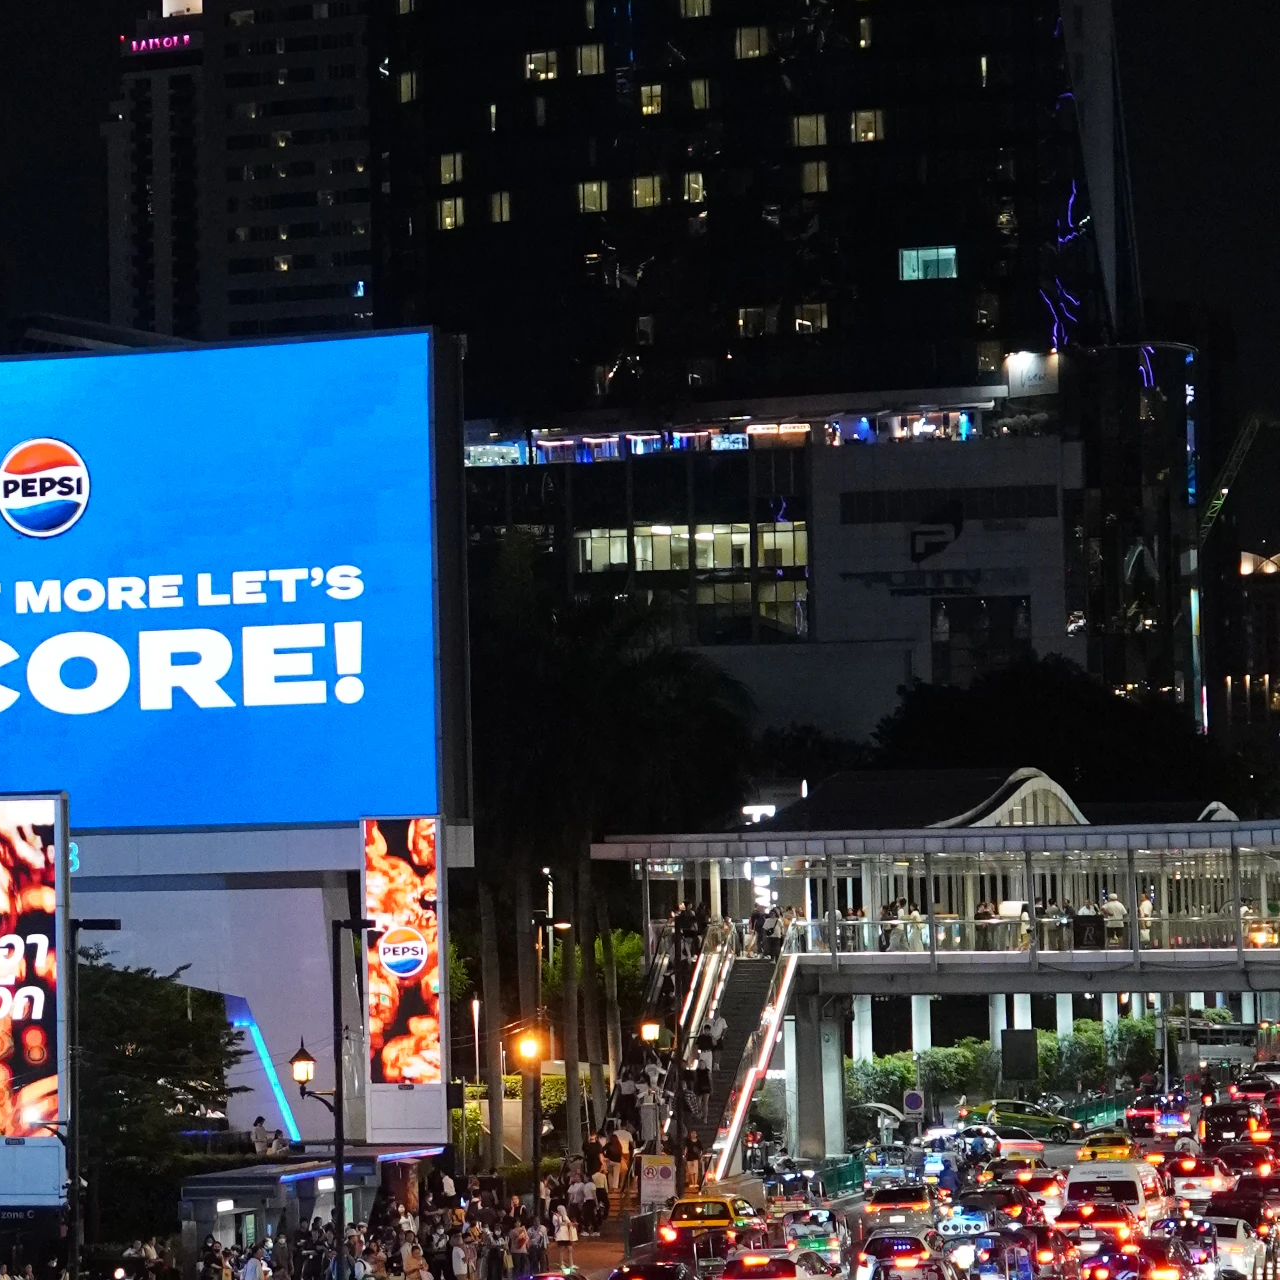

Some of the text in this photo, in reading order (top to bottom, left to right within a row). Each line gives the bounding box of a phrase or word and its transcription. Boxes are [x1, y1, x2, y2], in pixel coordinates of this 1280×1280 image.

[3, 476, 82, 498] PEPSI
[16, 574, 183, 614] MORE
[382, 946, 424, 958] PEPSI
[1, 1210, 35, 1219] zone C
